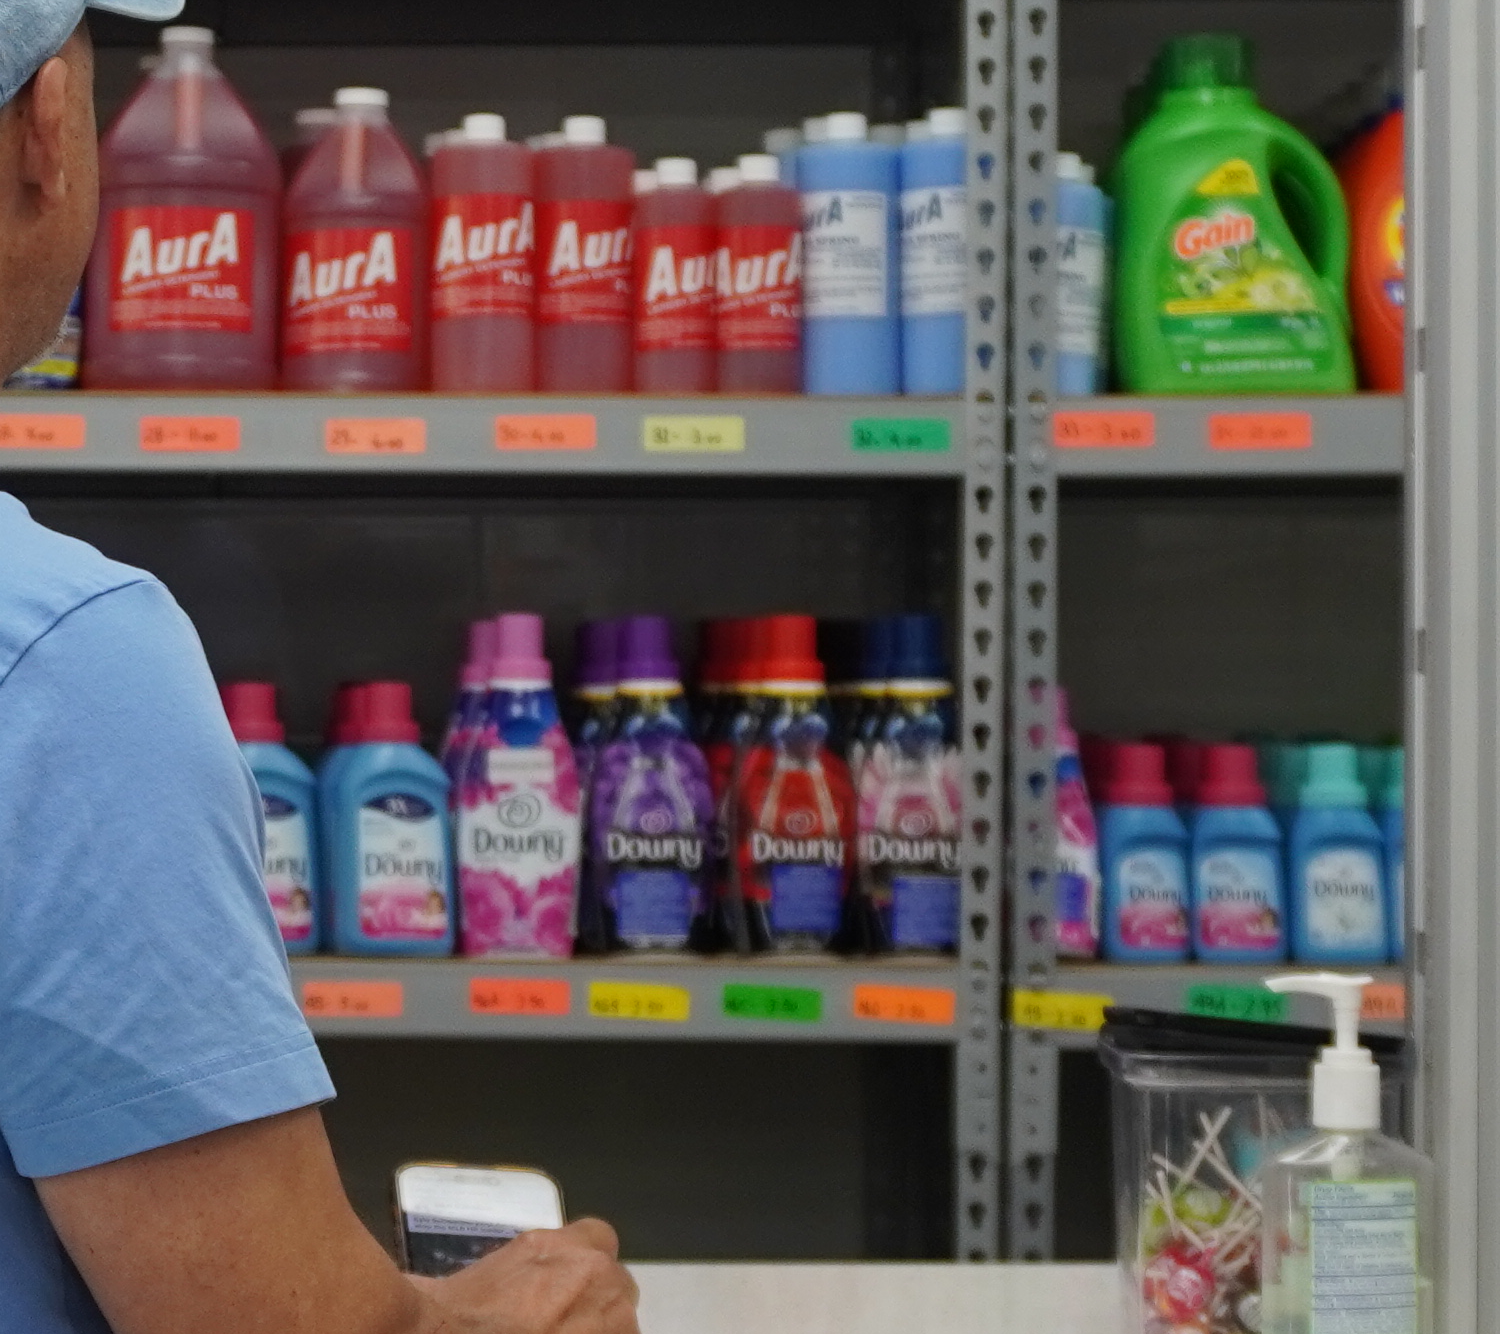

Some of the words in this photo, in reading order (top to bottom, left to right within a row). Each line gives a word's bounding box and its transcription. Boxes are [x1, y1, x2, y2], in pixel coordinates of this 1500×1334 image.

[121, 211, 240, 284] AurA
[548, 219, 632, 276] Aur
[1174, 213, 1257, 260] Gain
[289, 230, 398, 308] AurA
[189, 283, 239, 301] PLUS
[347, 302, 399, 319] PLUS
[474, 828, 566, 862] Downy
[606, 831, 702, 867] Downy
[751, 832, 845, 866] Downy
[364, 852, 444, 884] Downy
